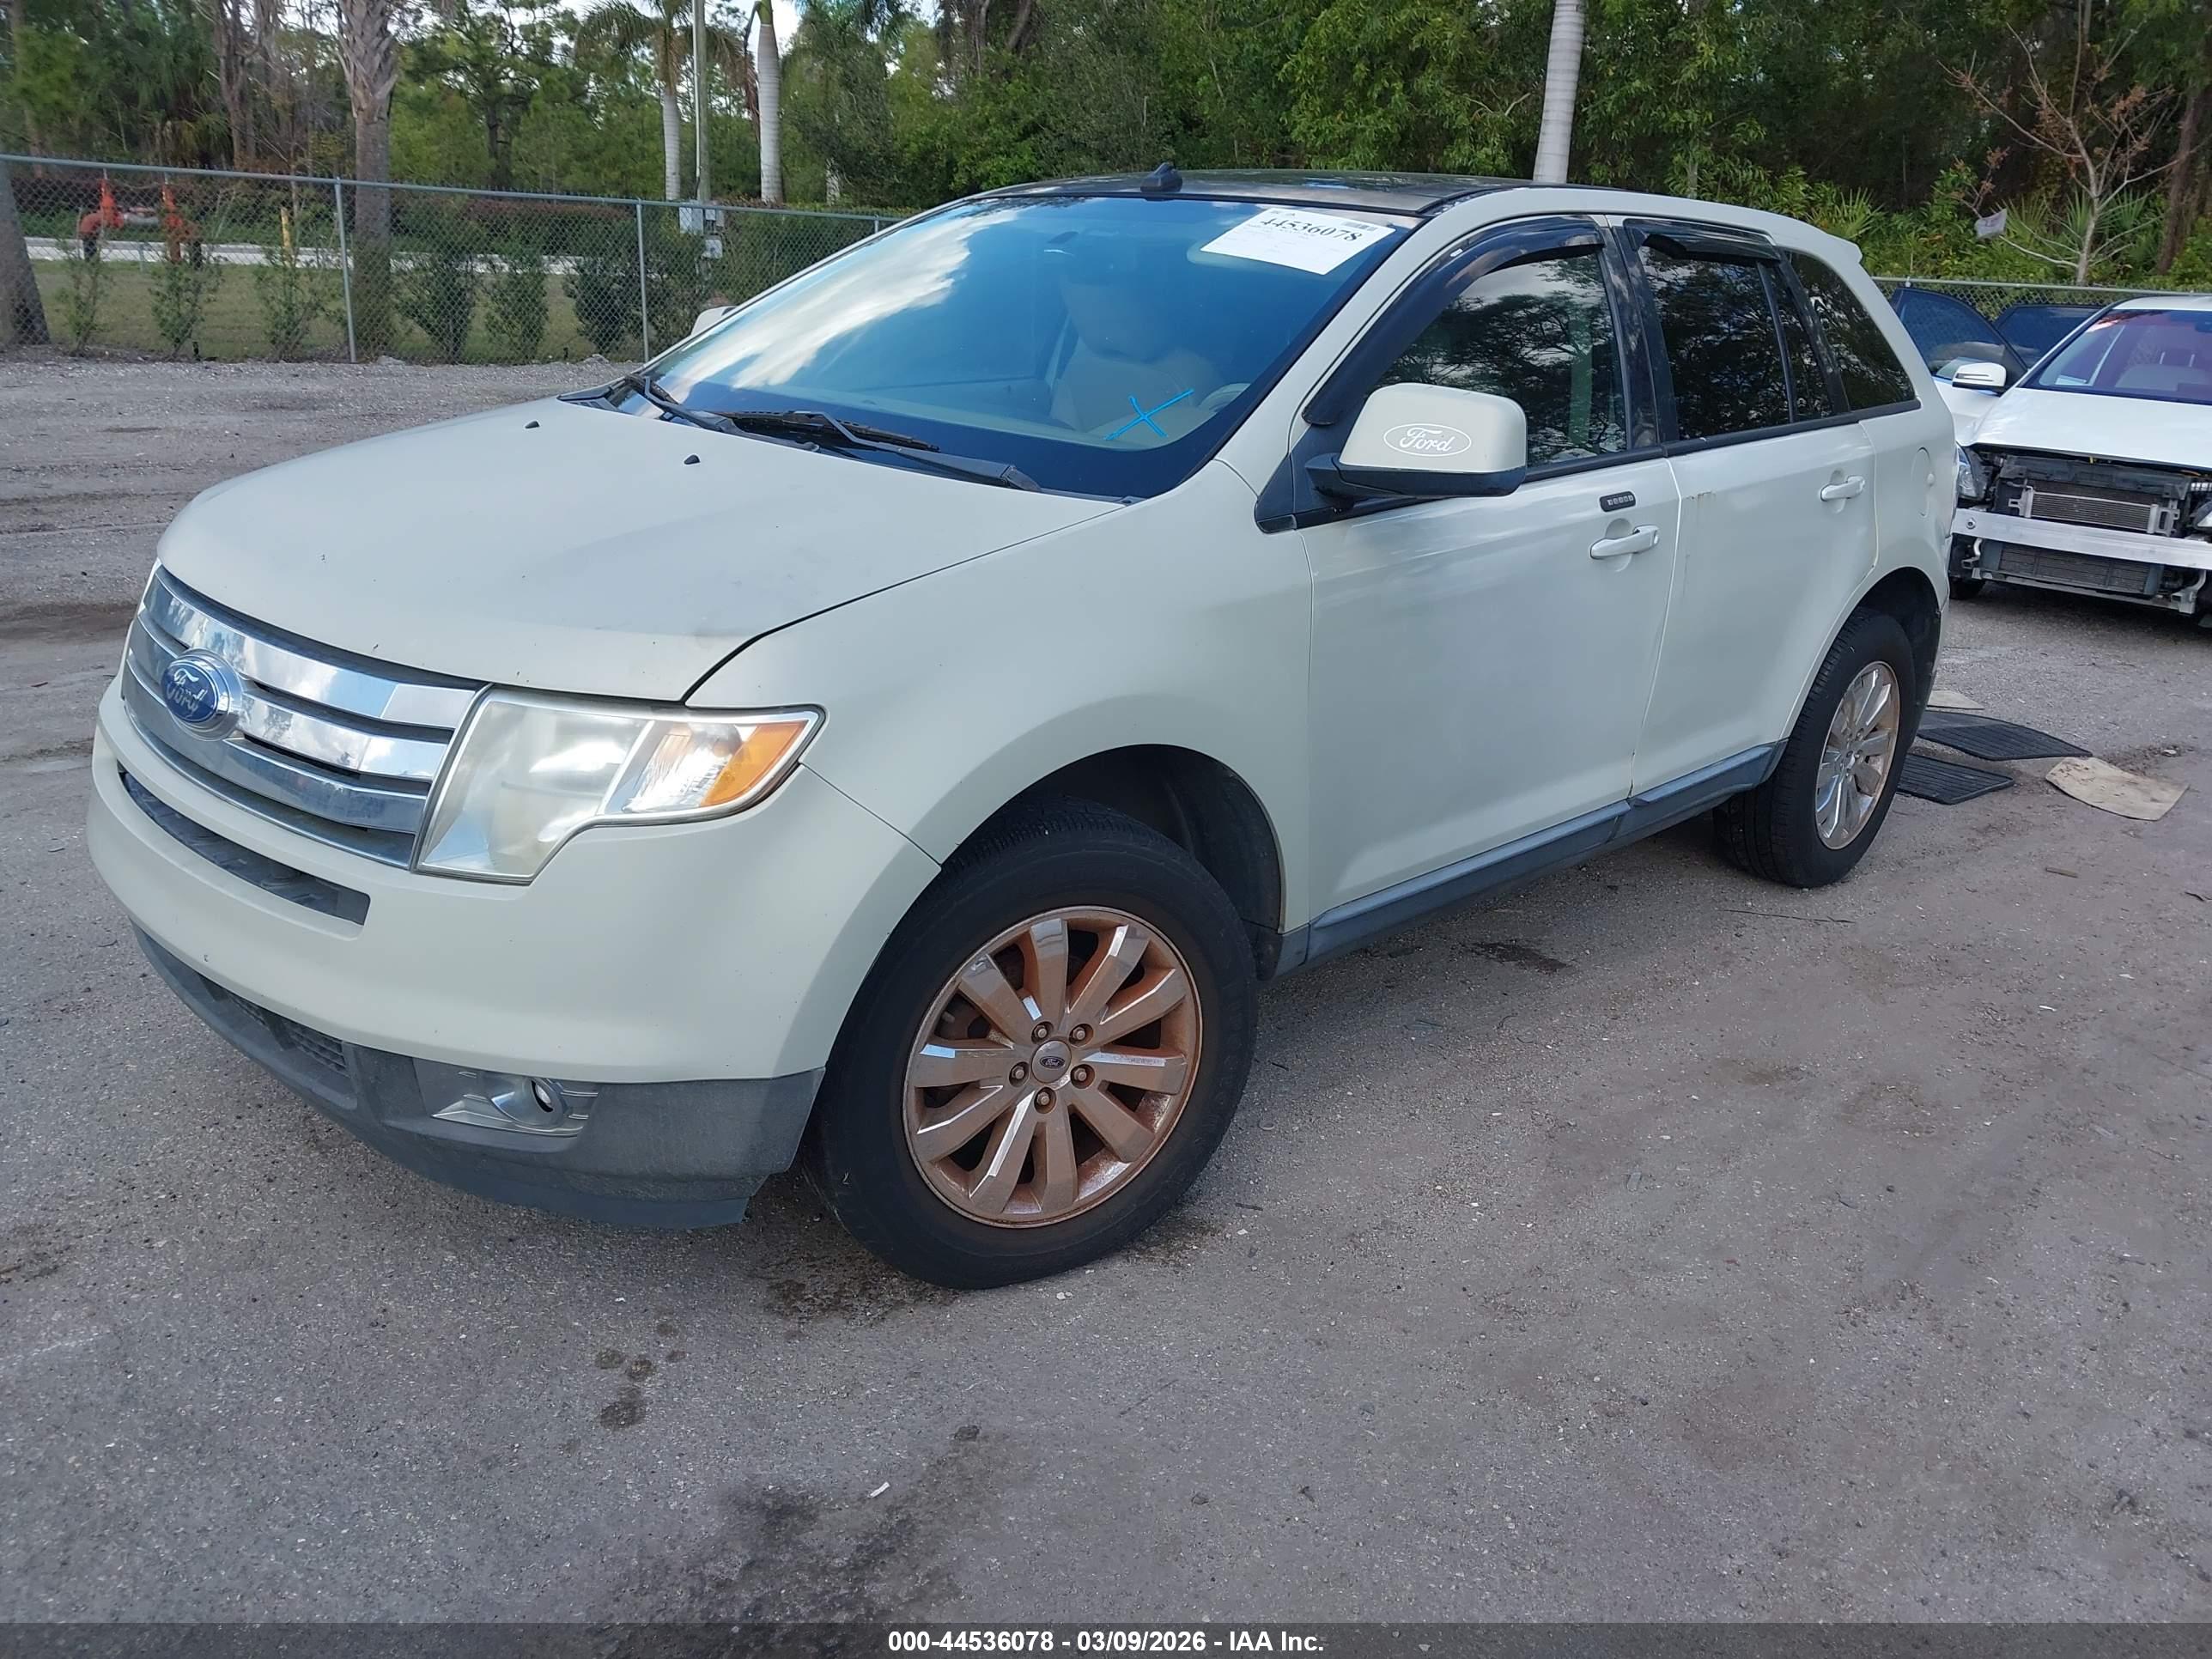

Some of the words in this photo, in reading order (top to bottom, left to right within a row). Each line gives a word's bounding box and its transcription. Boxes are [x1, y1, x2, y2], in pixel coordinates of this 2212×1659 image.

[1260, 217, 1362, 241] 44536078
[1400, 427, 1455, 452] Ford
[166, 668, 208, 713] Ford
